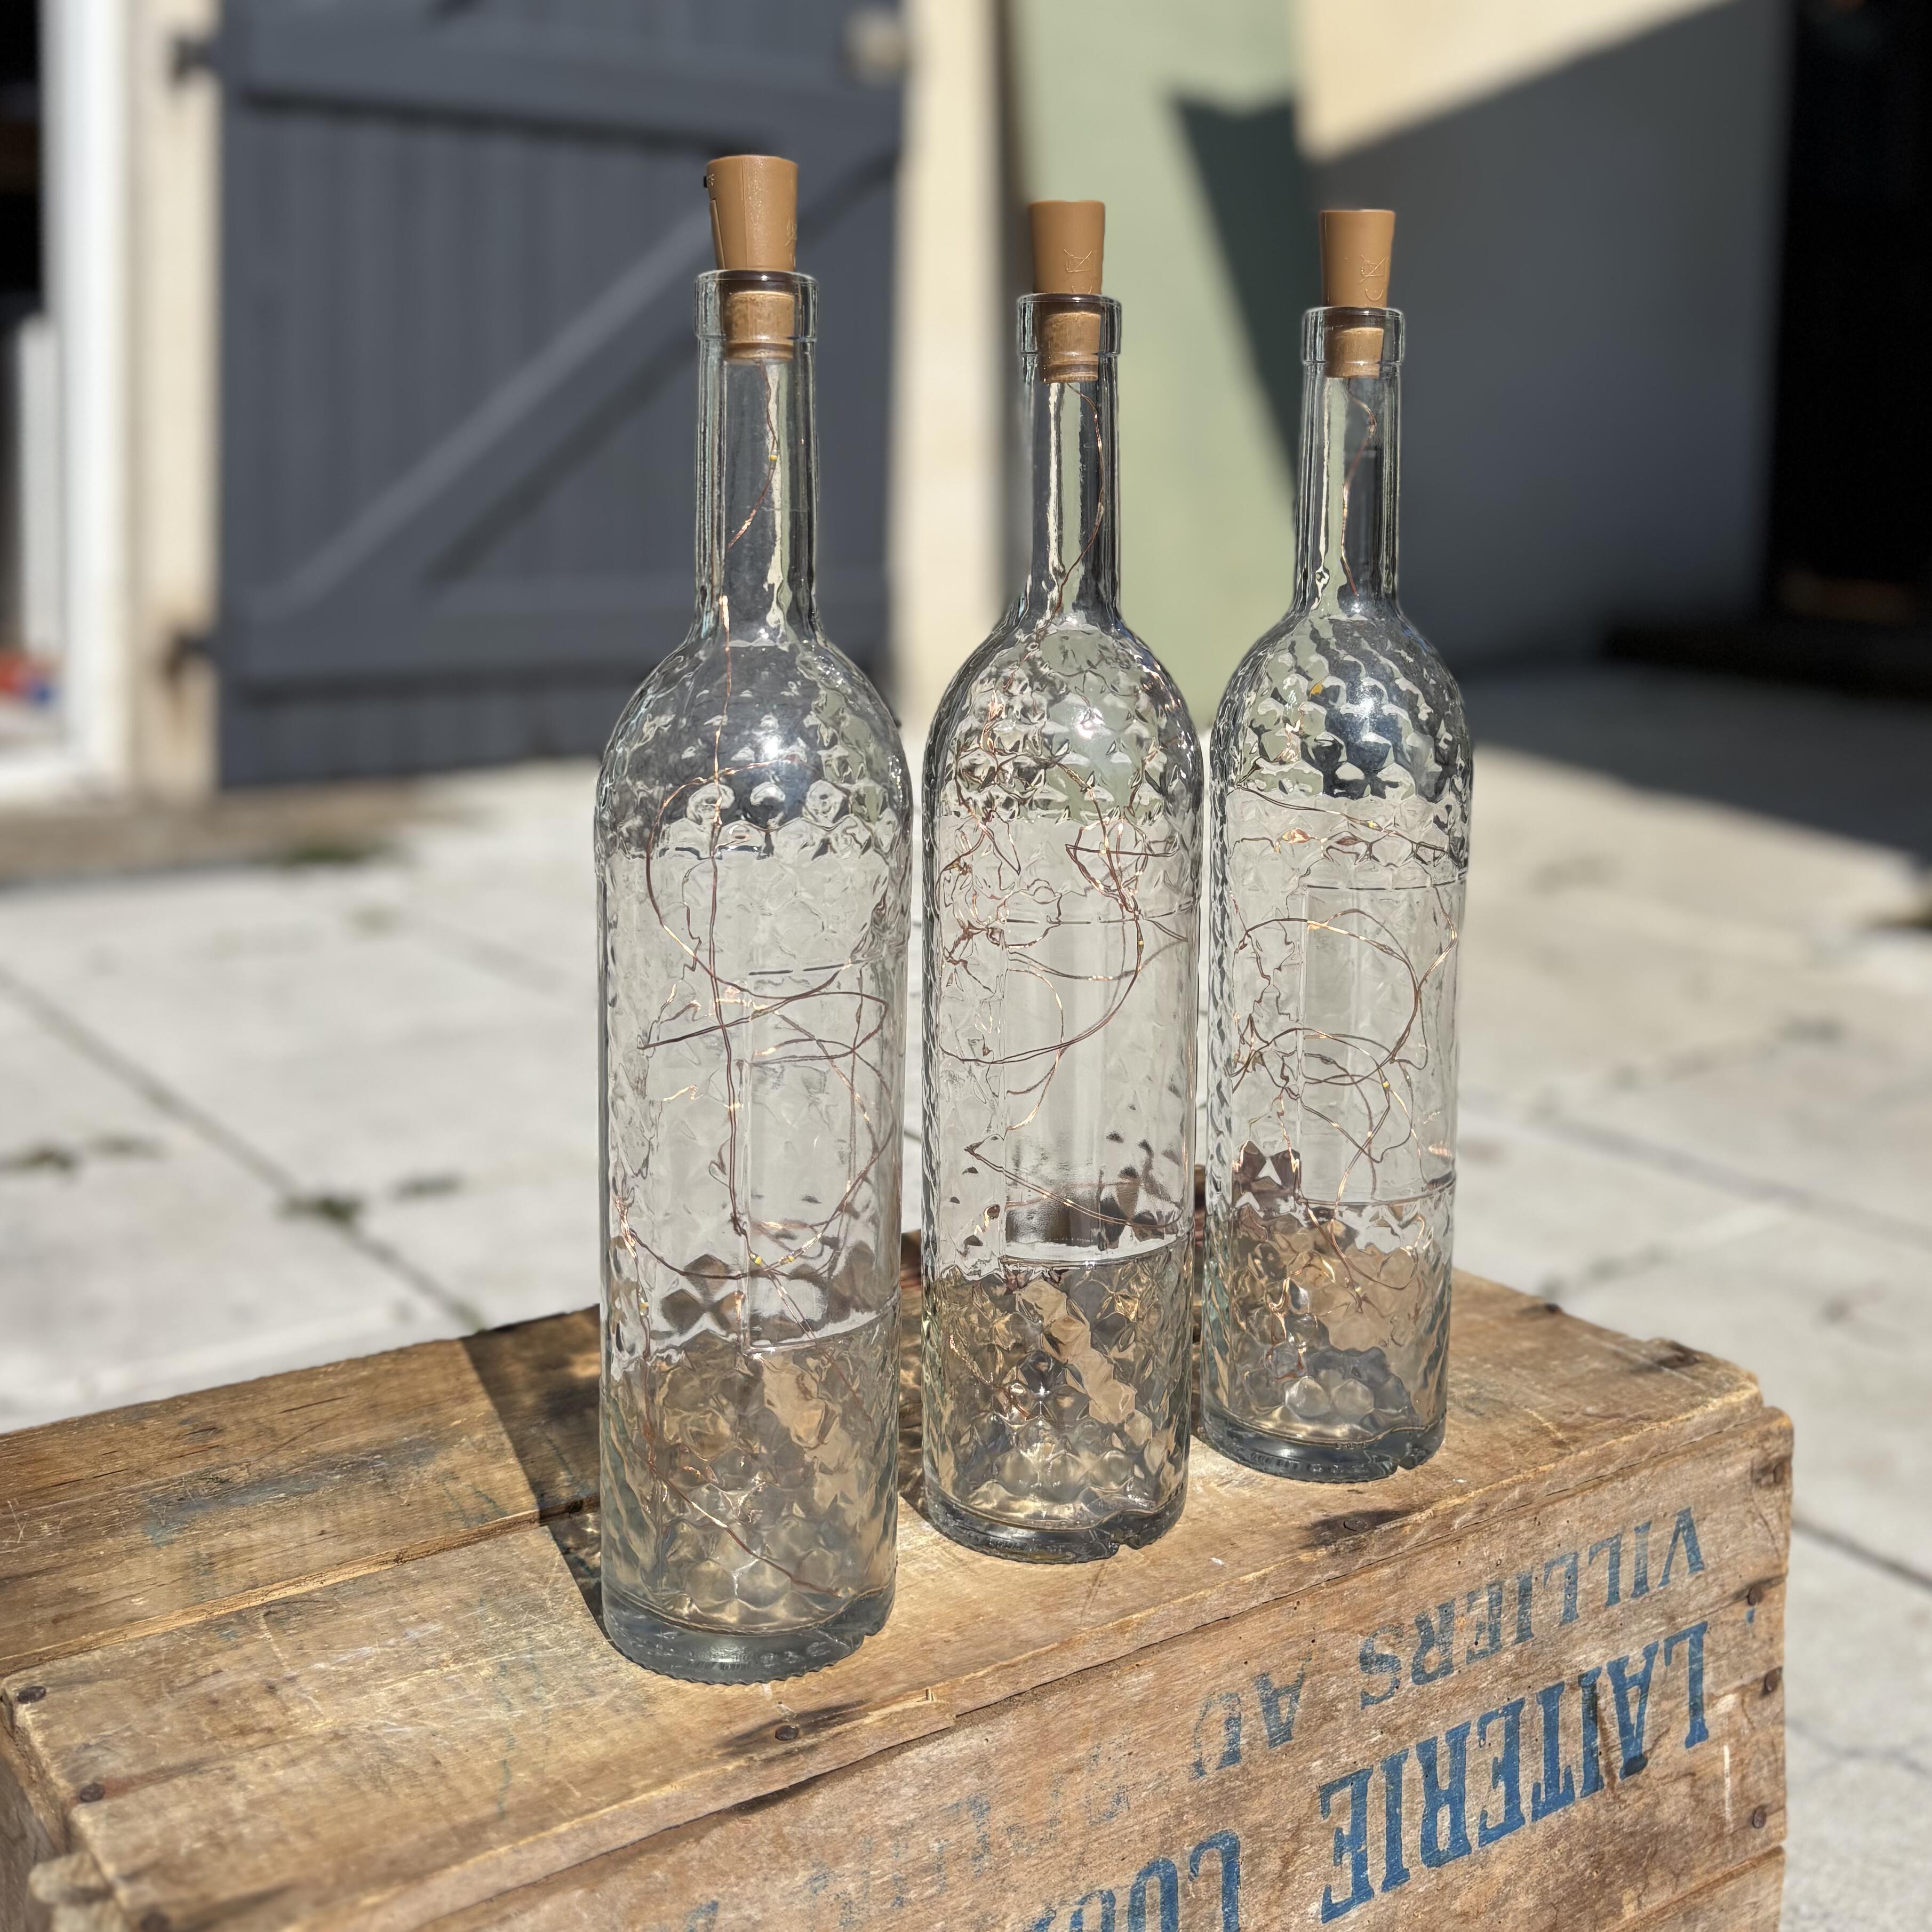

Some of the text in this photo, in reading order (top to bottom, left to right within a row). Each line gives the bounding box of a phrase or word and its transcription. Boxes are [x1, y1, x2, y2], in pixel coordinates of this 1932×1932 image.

[1189, 1507, 1705, 1781] VILLIERS AU
[1317, 1621, 1709, 1924] LAITERIE
